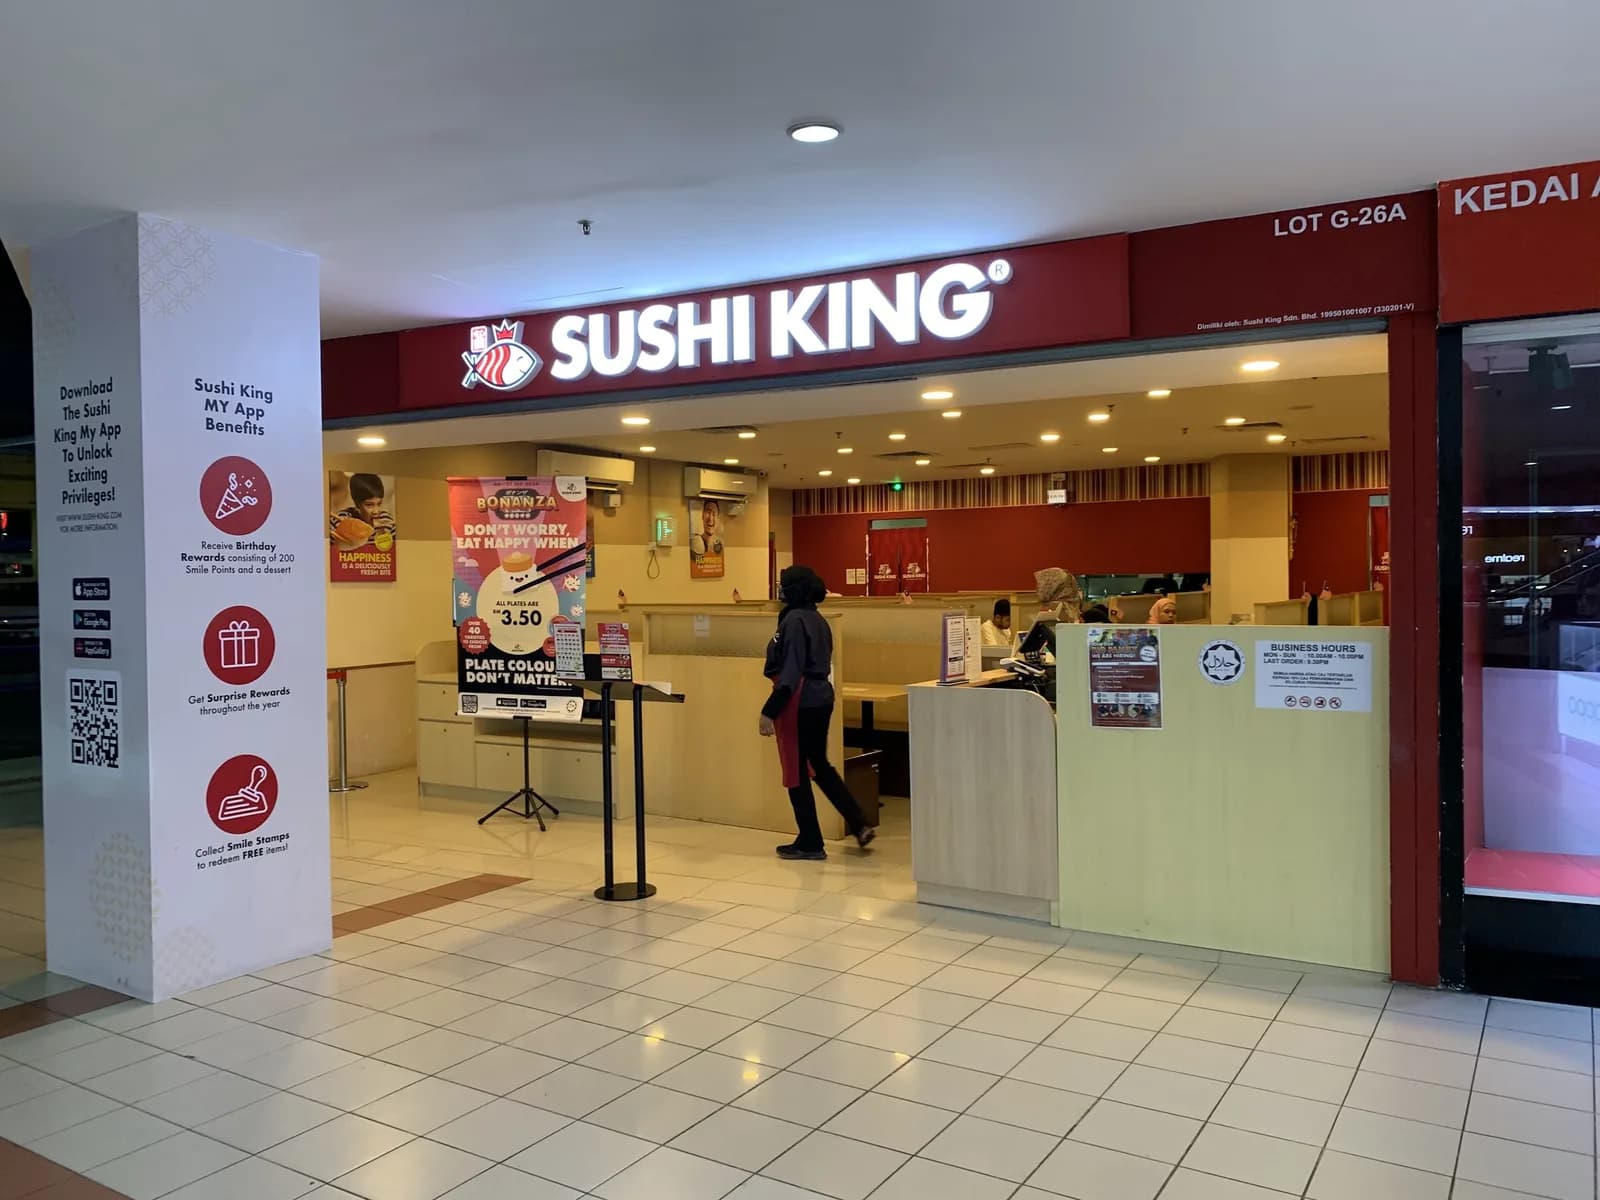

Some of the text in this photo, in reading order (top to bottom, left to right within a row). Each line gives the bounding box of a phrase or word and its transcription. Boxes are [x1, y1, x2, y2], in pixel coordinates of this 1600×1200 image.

[1455, 173, 1578, 214] KEDAI
[1274, 202, 1407, 236] LOT G-26A
[549, 294, 756, 380] SUSHI
[769, 262, 994, 358] KING
[1243, 317, 1263, 326] Sushi
[1265, 315, 1281, 324] King
[60, 377, 112, 400] Download
[194, 378, 273, 404] Sushi King
[63, 400, 110, 420] The Sushi
[204, 398, 265, 420] MY App
[54, 422, 121, 444] King My App
[205, 417, 265, 435] Benefits
[62, 442, 112, 462] To Unlock
[69, 466, 107, 484] Exciting
[62, 486, 115, 506] Privileges!
[477, 496, 557, 509] BONANZA
[464, 524, 570, 537] DON'T WORRY,
[201, 541, 276, 552] Receive Birthday
[457, 537, 579, 548] EAT HAPPY WHEN
[181, 553, 295, 564] Rewards consisting of 200
[339, 552, 391, 562] HAPPINESS
[185, 565, 209, 574] Smile
[211, 565, 235, 574] Points
[237, 565, 254, 574] and
[264, 565, 291, 574] dessert
[501, 609, 542, 625] 3.50
[468, 626, 480, 634] 40
[1271, 644, 1318, 652] BUSINESS
[465, 659, 555, 672] PLATE COLOU
[466, 671, 510, 684] DON'T
[188, 686, 290, 704] Get Surprise Rewards
[200, 700, 280, 715] throughout the year
[195, 832, 290, 857] Collect Smile Stamps
[208, 856, 240, 867] redeem
[242, 847, 263, 859] FREE
[266, 843, 288, 854] items!
